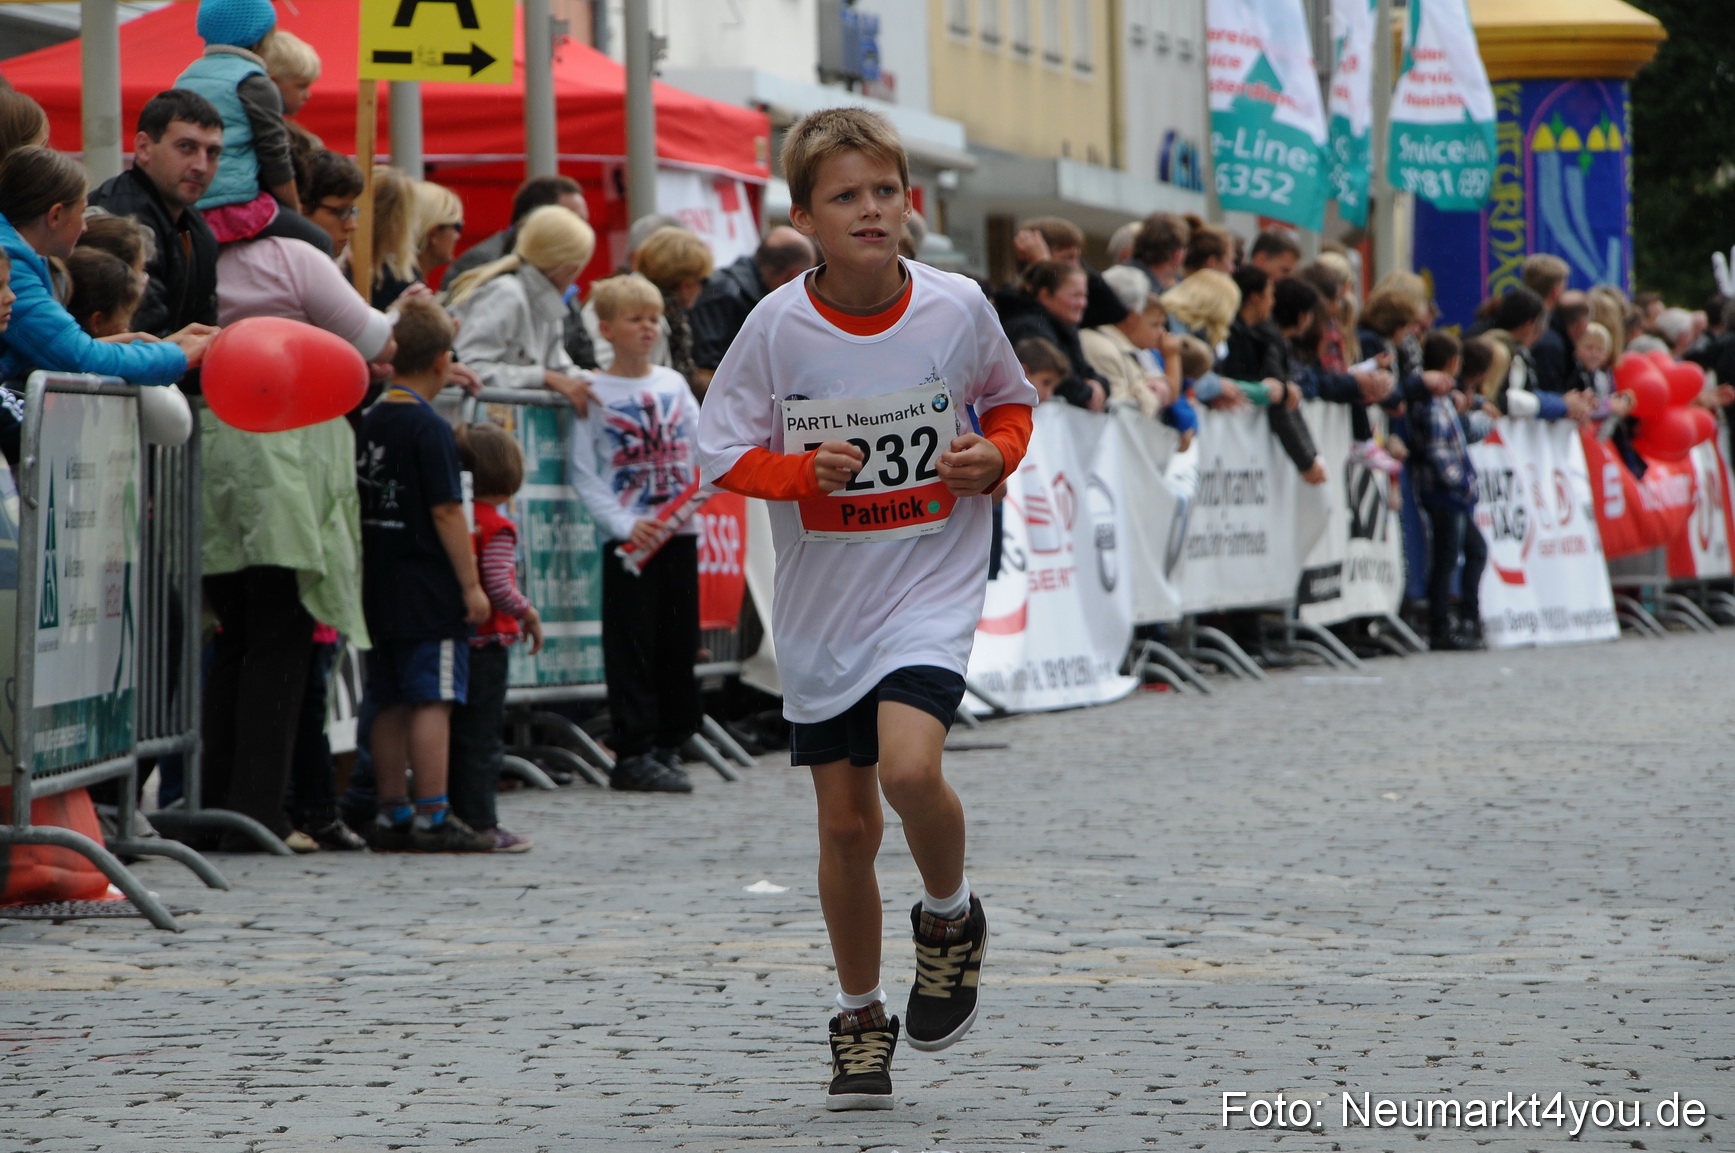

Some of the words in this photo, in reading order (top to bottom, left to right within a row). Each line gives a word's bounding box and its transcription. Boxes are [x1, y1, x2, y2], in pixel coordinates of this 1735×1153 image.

[1215, 162, 1295, 206] 6352
[787, 415, 843, 431] PARTL
[846, 402, 927, 428] Neumarkt
[804, 425, 939, 492] 232
[841, 496, 925, 526] Patrick
